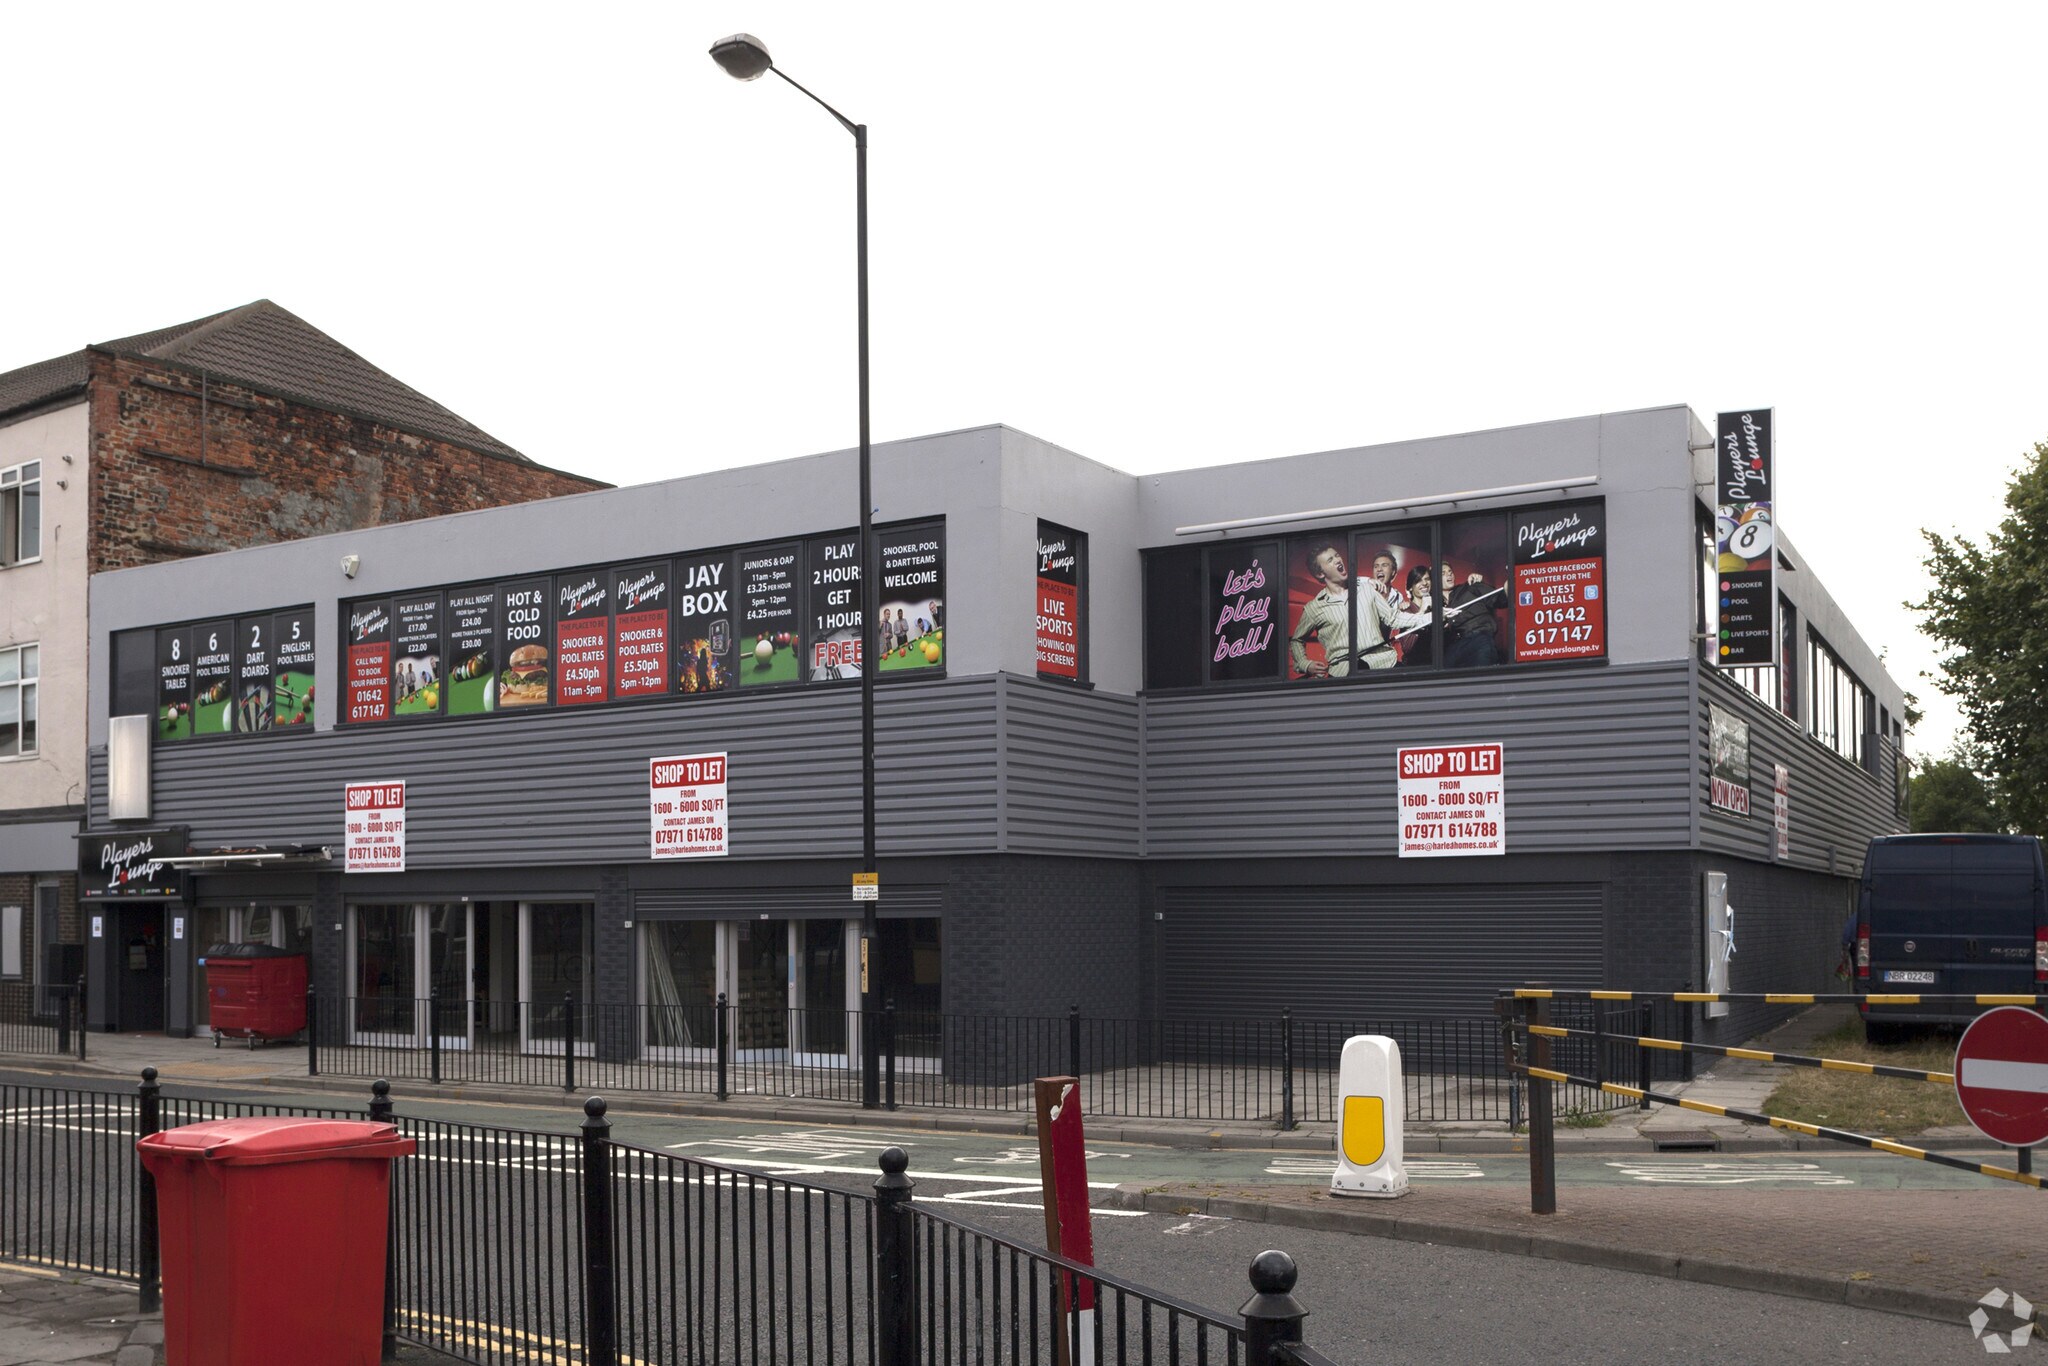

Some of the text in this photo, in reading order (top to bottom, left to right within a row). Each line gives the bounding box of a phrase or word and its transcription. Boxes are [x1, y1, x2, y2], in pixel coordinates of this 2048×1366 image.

[1726, 431, 1751, 500] Players
[1758, 512, 1766, 520] 5
[1518, 513, 1580, 547] Players
[1740, 525, 1758, 548] 8
[825, 543, 855, 560] PLAY
[883, 542, 938, 556] SNOOKER, POOL
[744, 556, 794, 570] JUNIORS & OAP
[886, 555, 935, 568] & DART TEAMS
[1560, 563, 1596, 572] FACEBOOK
[685, 563, 724, 589] JAY
[773, 572, 786, 580] 5pm
[814, 566, 861, 584] 2 HOUR
[885, 571, 937, 587] WELCOME
[1223, 559, 1265, 597] let's
[1532, 575, 1561, 584] TWITTER
[561, 578, 597, 605] Players
[618, 571, 655, 599] Players
[747, 583, 767, 593] £3.25
[1541, 584, 1576, 595] LATEST
[450, 594, 493, 607] PLAY ALL NIGHT
[507, 590, 542, 606] HOT &
[682, 590, 728, 616] BOX
[752, 596, 786, 607] 5pm 12pm
[827, 589, 851, 605] GET
[1542, 594, 1574, 605] DEALS
[400, 606, 413, 614] PLAY
[425, 602, 436, 610] DAY
[747, 609, 767, 619] £4.25
[1044, 598, 1064, 616] LIVE
[351, 606, 381, 631] Players
[462, 617, 481, 627] £24.00
[509, 608, 540, 623] COLD
[818, 616, 822, 629] 1
[1215, 596, 1271, 635] play
[1535, 607, 1585, 624] 01642
[292, 621, 300, 639] 5
[408, 623, 427, 632] £17.00
[507, 625, 541, 640] FOOD
[1036, 615, 1072, 636] SPORTS
[209, 633, 218, 651] 6
[251, 625, 260, 648] 2
[620, 628, 663, 642] SNOOKER &
[172, 639, 180, 660] 8
[282, 642, 310, 653] ENGLISH
[408, 643, 427, 652] £22.00
[462, 639, 481, 649] £30.00
[562, 636, 604, 649] SNOOKER &
[619, 643, 664, 656] POOL RATES
[1037, 637, 1075, 653] HOWING ON
[1214, 623, 1274, 662] ball!
[561, 651, 604, 663] POOL RATES
[815, 639, 862, 668] FREE
[1520, 645, 1599, 656] www.playerslounge.tv
[197, 653, 229, 666] AMERICAN
[246, 652, 265, 664] DART
[277, 653, 314, 665] POOL TABLES
[1047, 652, 1074, 666] SCREENS
[162, 664, 190, 677] SNOOKER
[197, 665, 230, 677] POOL TABLES
[242, 664, 269, 678] BOARDS
[624, 658, 659, 673] £5.50ph
[566, 666, 599, 681] £4.50ph
[165, 678, 186, 690] TABLES
[366, 678, 387, 686] PARTIES
[621, 679, 636, 690] 5pm
[357, 689, 381, 702] 01642
[564, 686, 582, 696] 11am
[1404, 750, 1496, 775] SHOP TO LET
[655, 761, 722, 784] SHOP TO LET
[1439, 781, 1460, 790] FROM
[349, 788, 401, 807] SHOP TO LET
[1402, 794, 1427, 807] 1600
[1439, 793, 1465, 805] 6000
[1468, 791, 1499, 805] SQ/FT
[1711, 777, 1748, 814] NOW OPEN
[654, 799, 724, 814] 1600 6000 SQ/FT
[1416, 810, 1485, 820] CONTACT JAMES ON
[656, 827, 722, 844] 07971 614788
[1405, 822, 1497, 839] 07971 614788
[102, 837, 153, 869] Players
[349, 846, 401, 859] 07971 614788
[1889, 971, 1932, 980] NBR 02248
